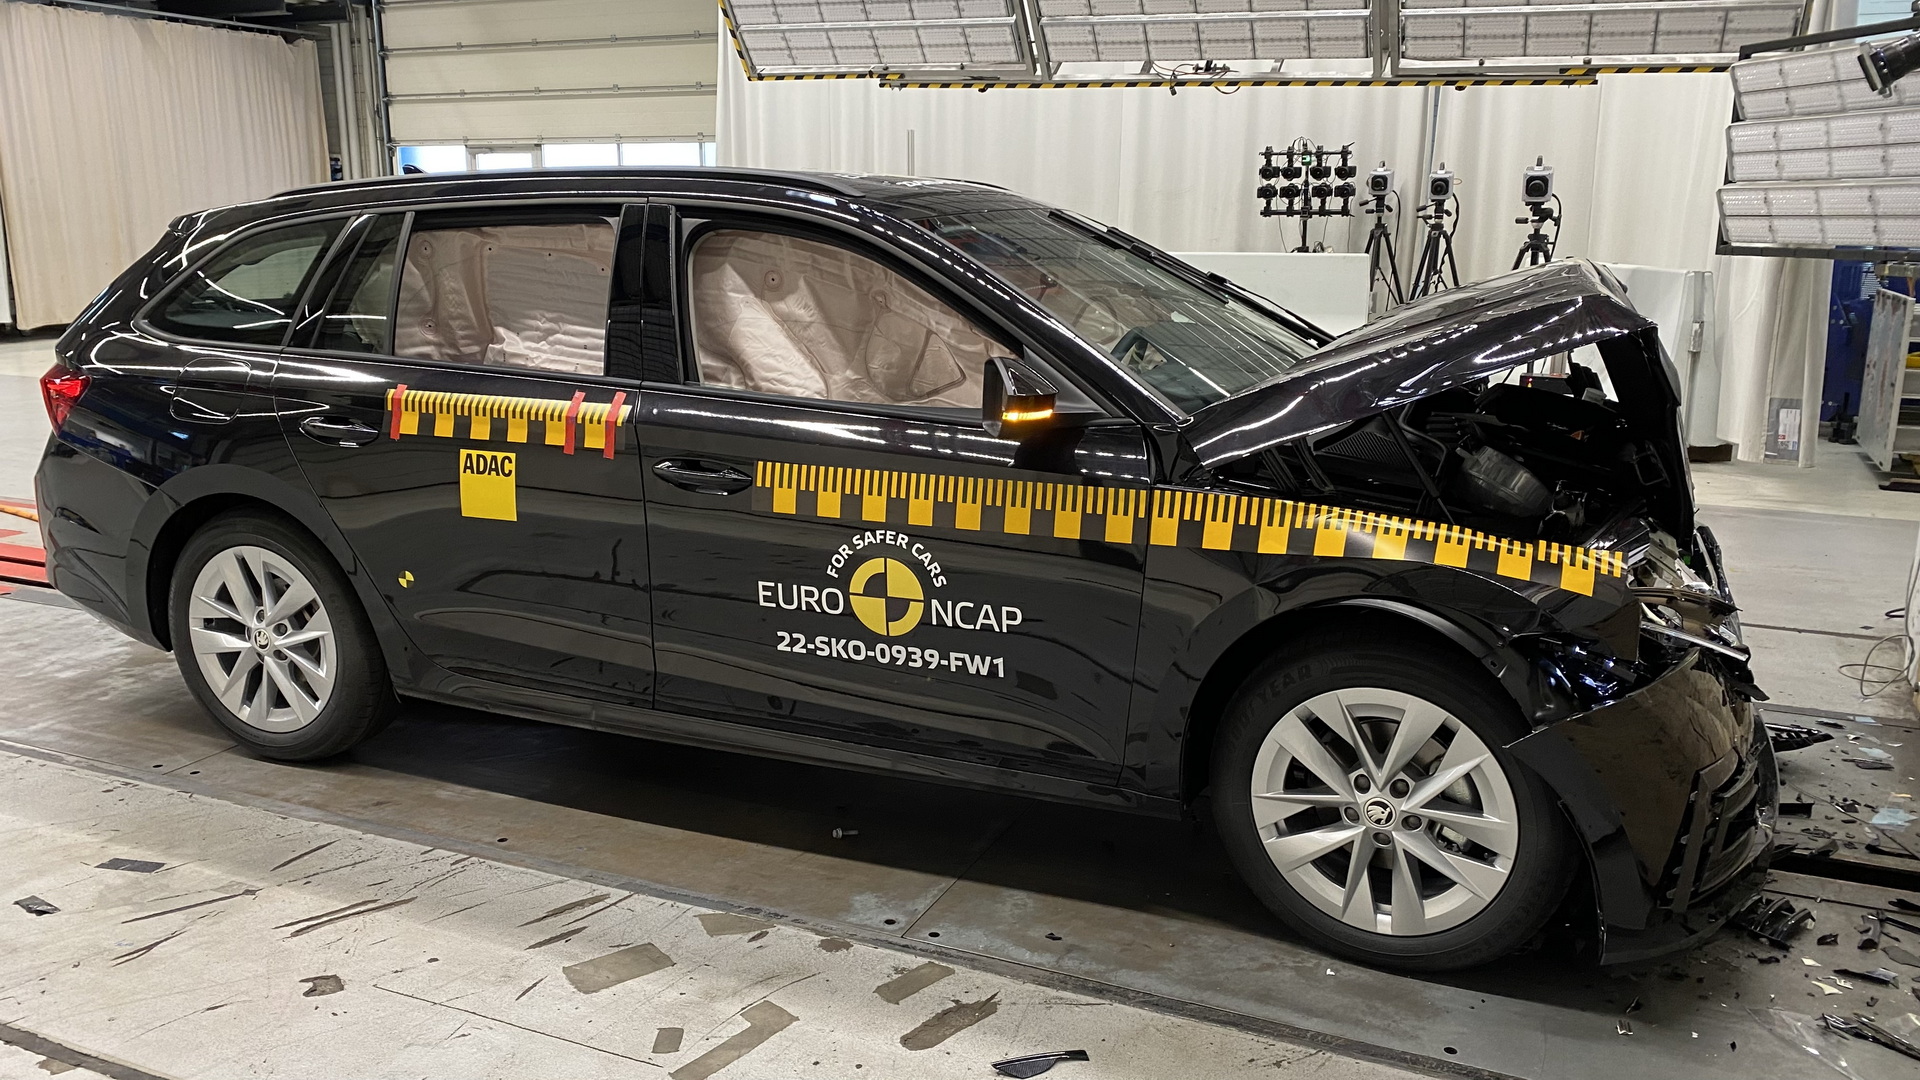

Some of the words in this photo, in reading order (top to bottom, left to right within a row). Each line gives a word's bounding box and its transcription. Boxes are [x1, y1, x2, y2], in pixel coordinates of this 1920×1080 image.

[463, 453, 512, 477] ADAC
[826, 543, 854, 579] FOR
[852, 529, 909, 550] SAFER
[911, 542, 947, 588] CARS
[757, 580, 844, 615] EURO
[931, 599, 1023, 633] NCAP
[776, 631, 1005, 678] 22-SKO-0939-FW1
